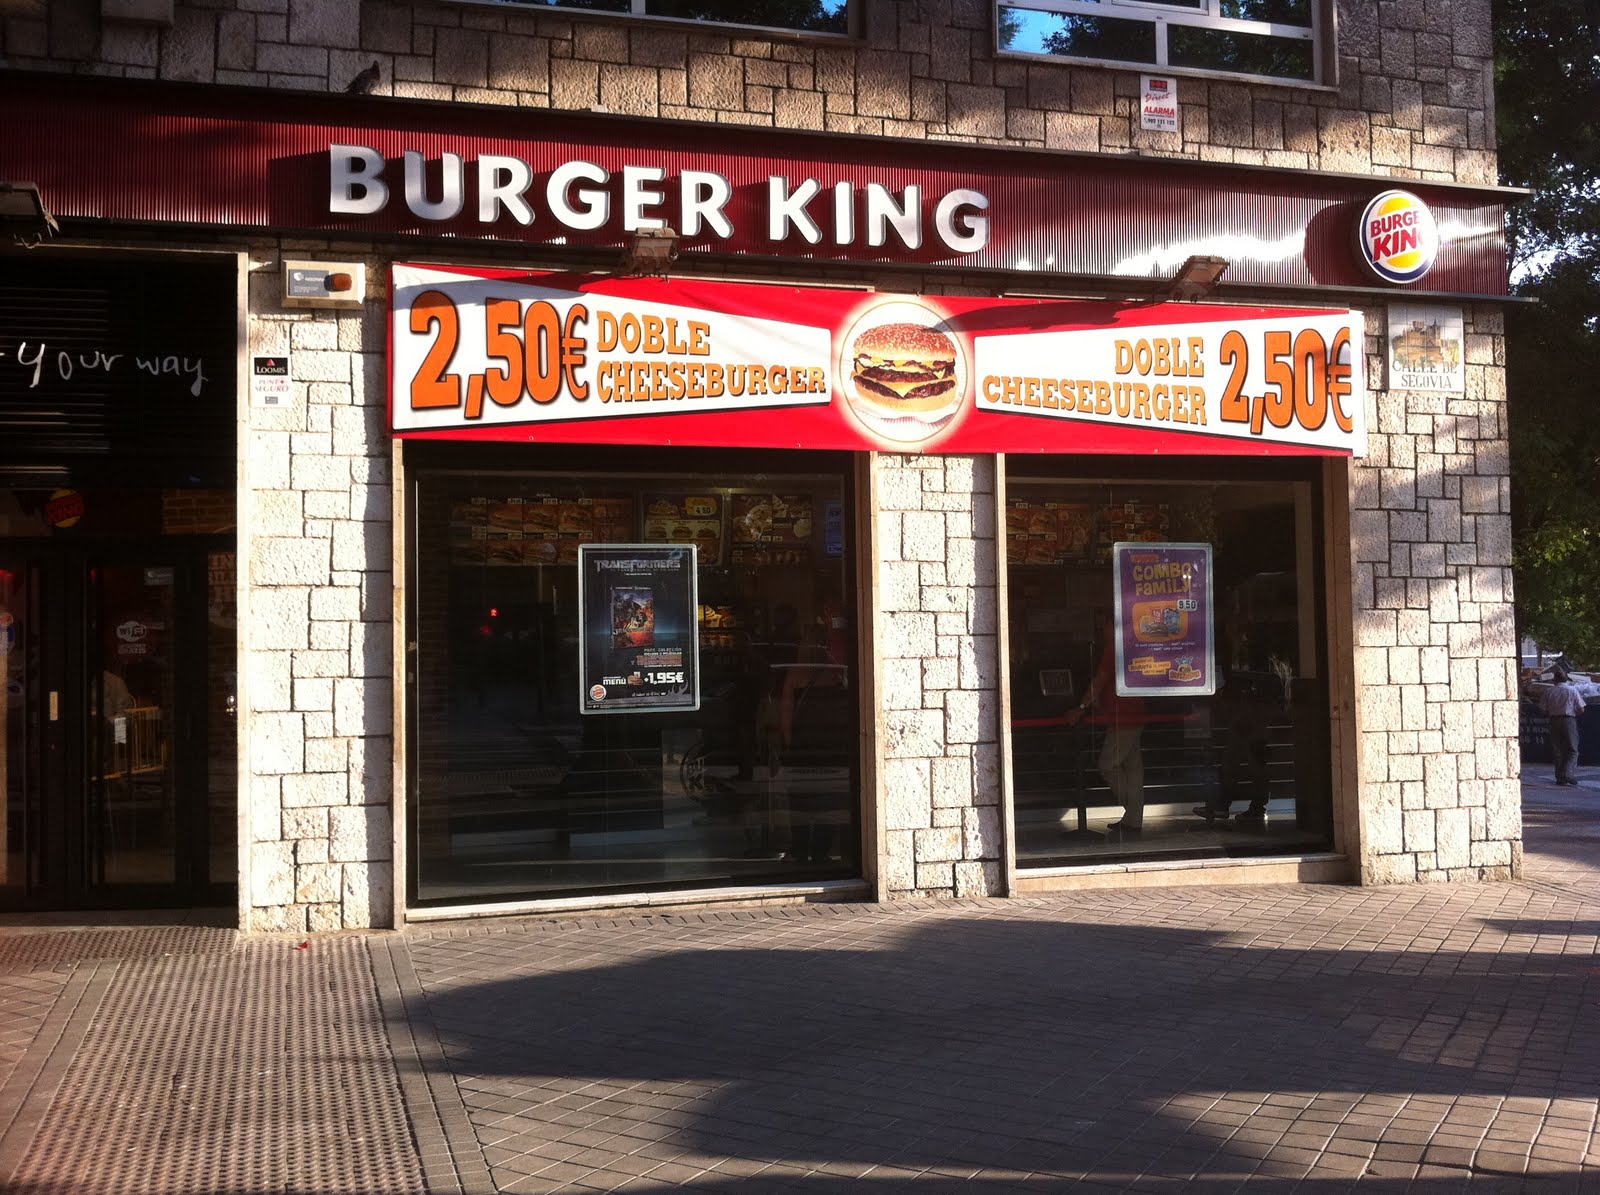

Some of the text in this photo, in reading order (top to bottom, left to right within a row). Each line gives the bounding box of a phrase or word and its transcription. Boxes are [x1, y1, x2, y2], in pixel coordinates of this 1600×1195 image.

[1144, 106, 1174, 117] ALARMA
[329, 143, 991, 253] BURGER KING
[1370, 210, 1421, 239] BURGE
[596, 309, 710, 356] DOBLE
[256, 366, 286, 374] LOOMIS
[409, 289, 590, 420] 2,50€
[1114, 336, 1205, 378] DOBLE
[1392, 360, 1457, 374] CALLE DE
[136, 355, 209, 397] way
[596, 360, 826, 403] CHEESEBURGER
[1219, 326, 1354, 436] 2,50€
[1401, 374, 1452, 389] SEGOVIA
[982, 374, 1208, 426] CHEESEBURGER
[594, 559, 681, 573] TRANSFORMERS
[1133, 562, 1192, 581] COMBO
